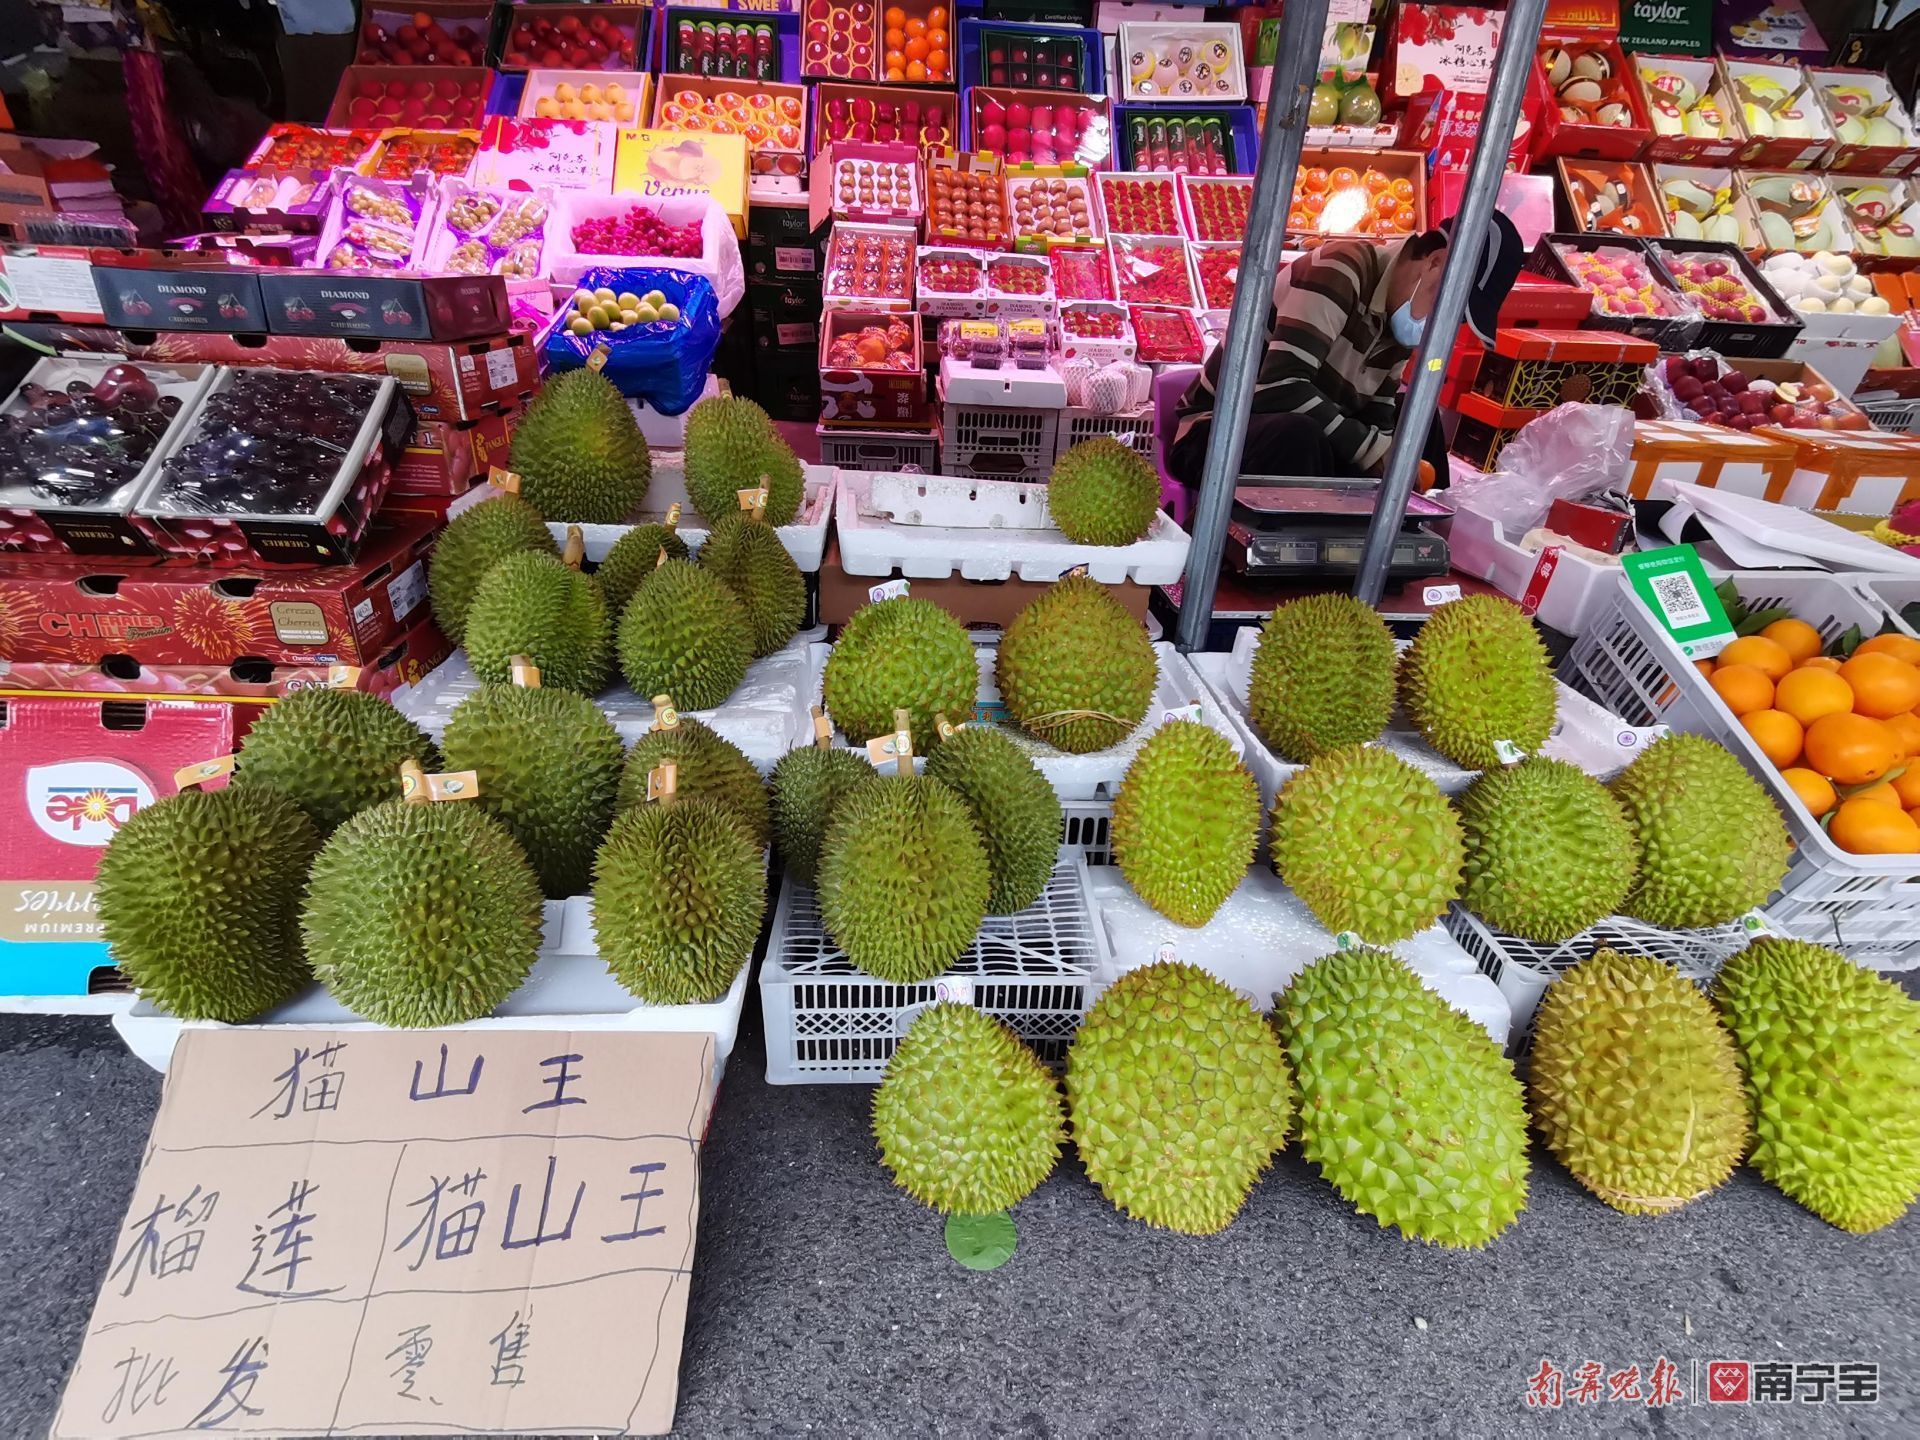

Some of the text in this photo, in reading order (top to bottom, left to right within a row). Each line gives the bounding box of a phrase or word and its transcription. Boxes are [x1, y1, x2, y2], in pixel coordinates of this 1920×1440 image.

[1633, 1, 1688, 23] taylor
[1632, 37, 1668, 46] ZEALAND
[1669, 39, 1701, 48] APPLES
[157, 284, 207, 295] DIAMOND
[320, 290, 370, 300] DIAMOND
[66, 530, 115, 539] CHERRIES
[262, 539, 310, 548] CHERRIES
[127, 626, 173, 641] Premium
[46, 794, 138, 831] Dole
[24, 922, 106, 934] PREMIUM
[250, 1042, 588, 1120] 猫山王
[110, 1156, 668, 1298] 榴莲 猫山王
[102, 1304, 535, 1430] 批发 零售
